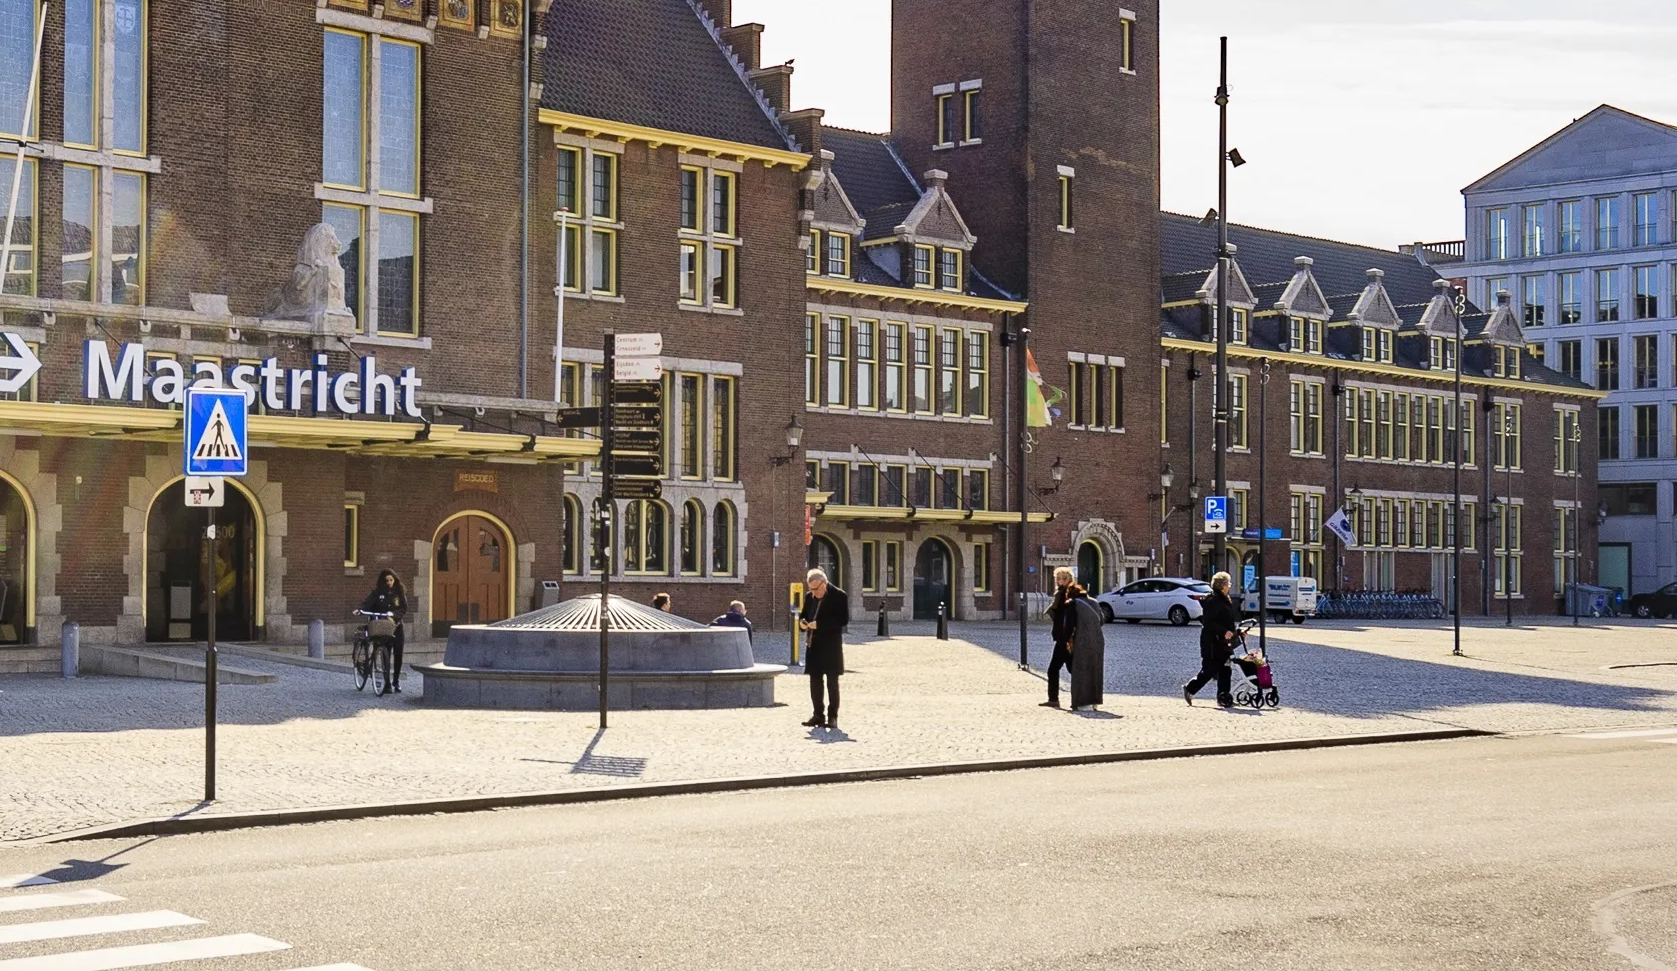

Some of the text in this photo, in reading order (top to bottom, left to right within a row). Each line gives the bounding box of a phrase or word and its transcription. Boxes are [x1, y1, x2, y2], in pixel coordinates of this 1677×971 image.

[83, 338, 422, 418] Maastricht
[459, 473, 494, 483] REISGOED
[1207, 499, 1217, 514] P
